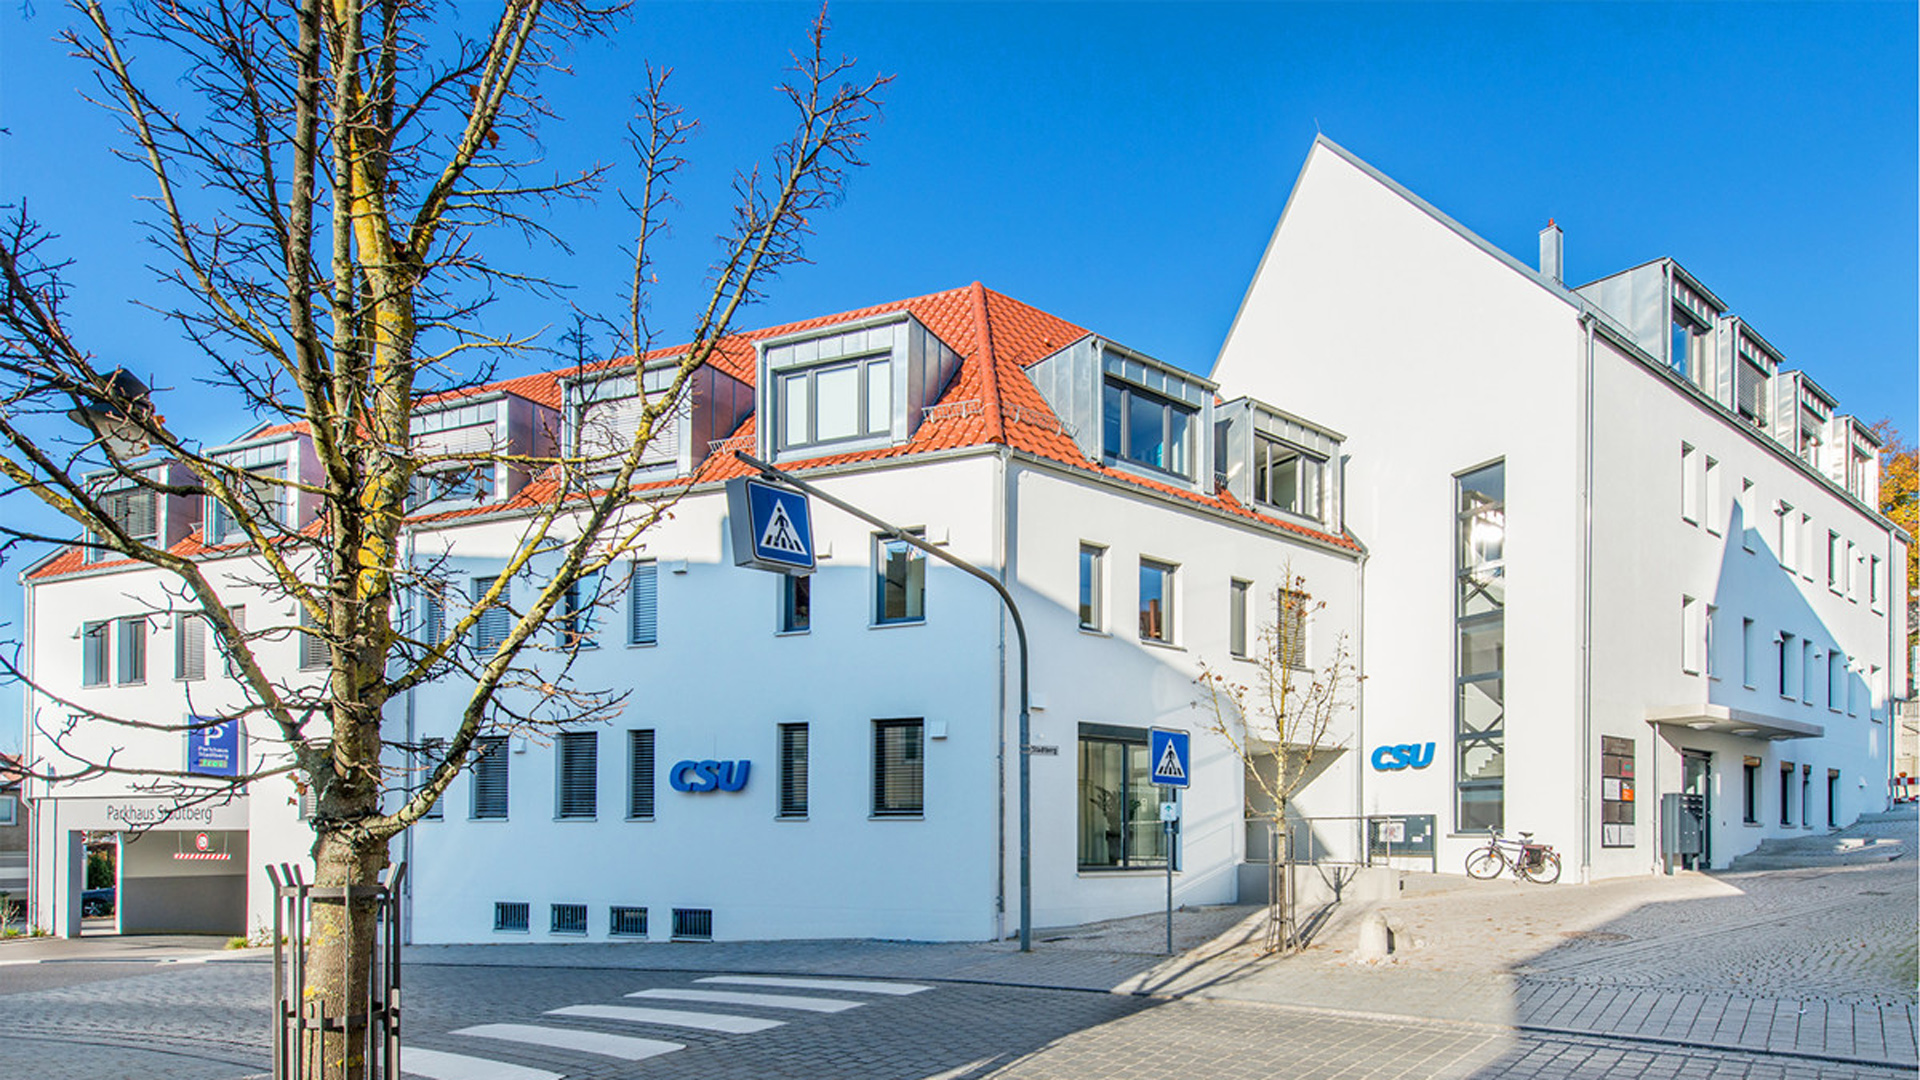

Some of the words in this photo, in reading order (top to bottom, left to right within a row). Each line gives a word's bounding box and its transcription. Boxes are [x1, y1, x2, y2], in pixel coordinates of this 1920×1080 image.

[1371, 742, 1436, 771] CSU
[670, 760, 751, 792] CSU
[106, 804, 154, 820] Parkhaus
